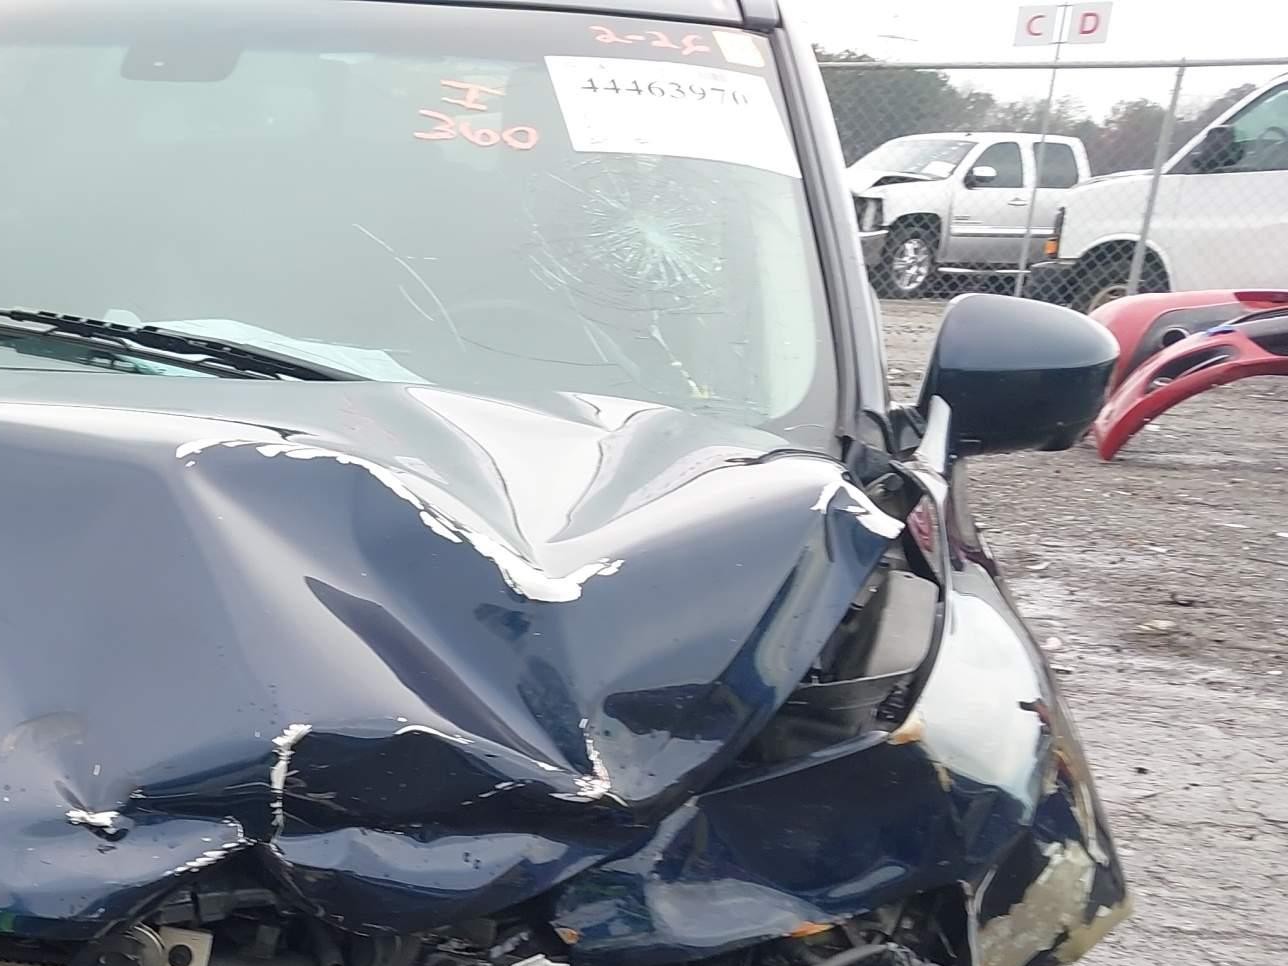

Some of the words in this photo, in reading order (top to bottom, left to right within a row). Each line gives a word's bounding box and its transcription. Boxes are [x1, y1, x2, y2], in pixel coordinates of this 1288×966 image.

[1026, 14, 1047, 37] C
[1078, 11, 1101, 36] D
[413, 108, 539, 150] 360
